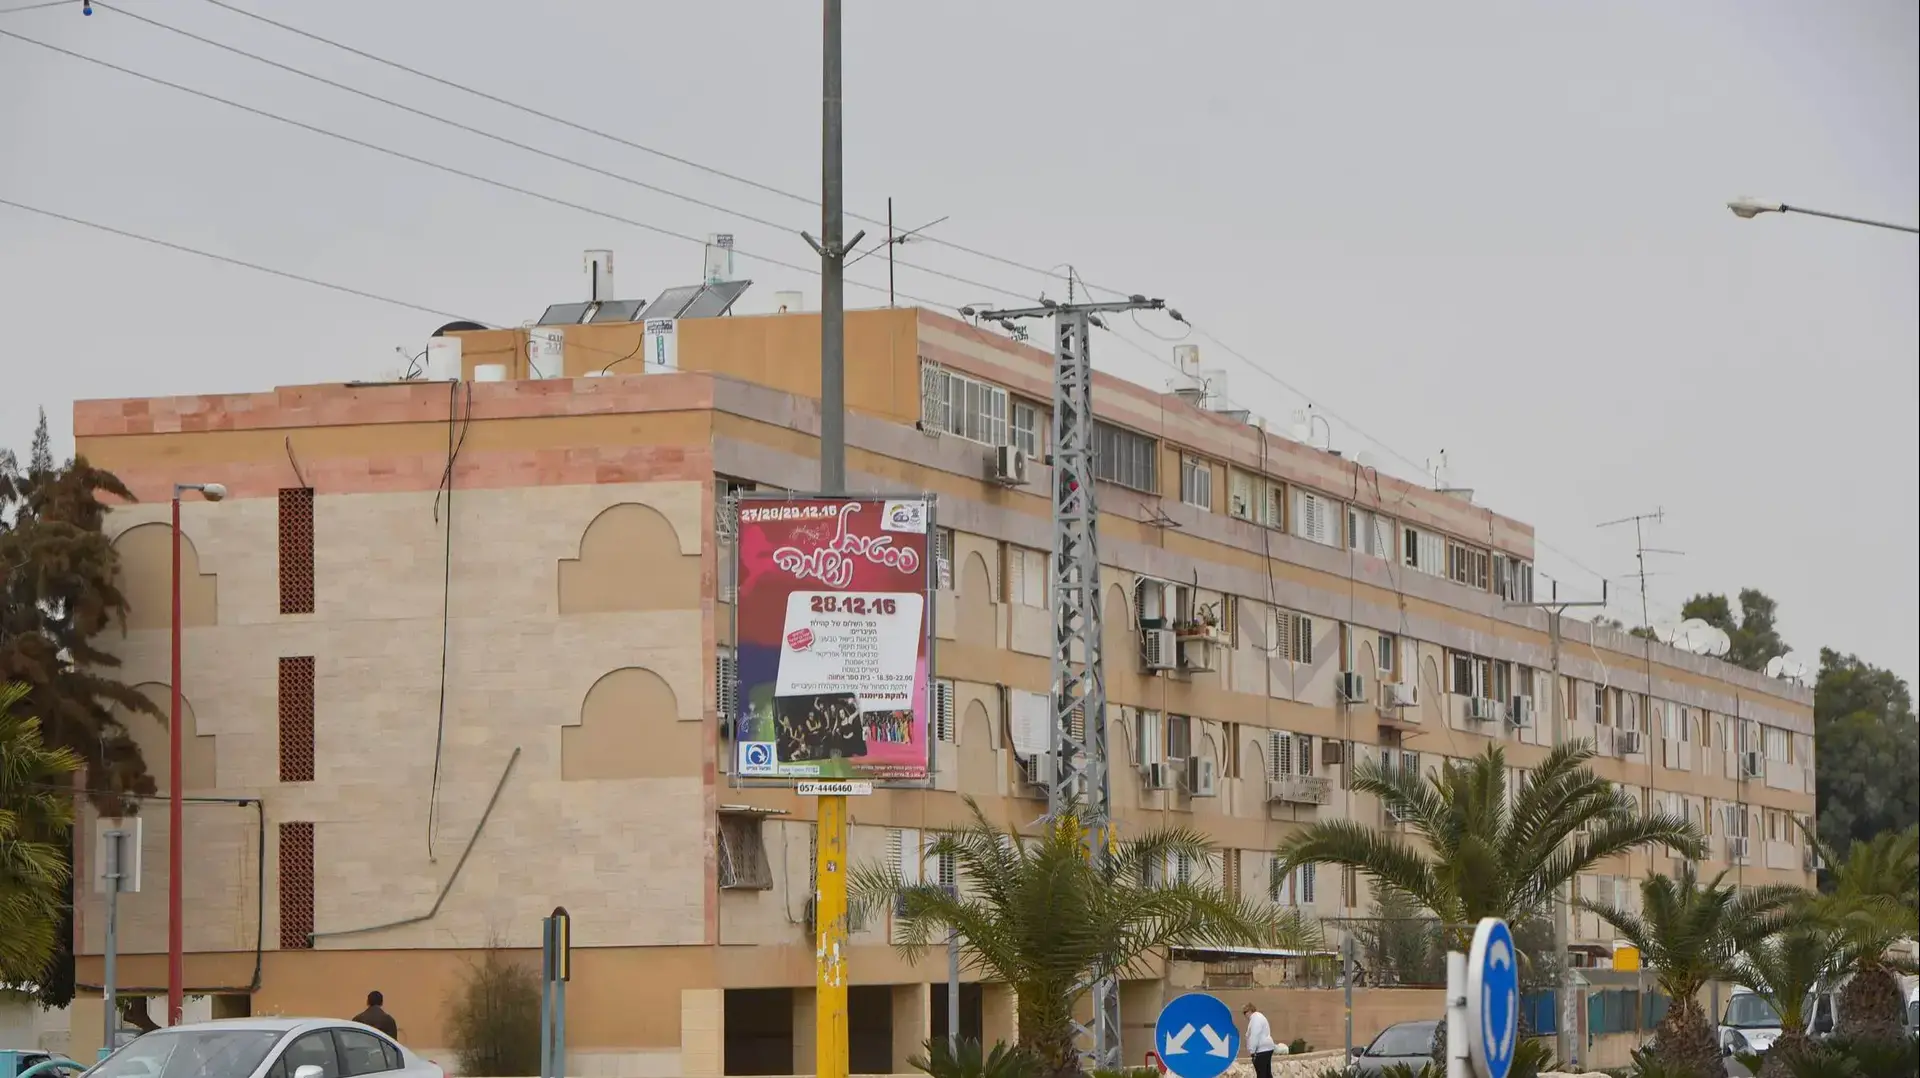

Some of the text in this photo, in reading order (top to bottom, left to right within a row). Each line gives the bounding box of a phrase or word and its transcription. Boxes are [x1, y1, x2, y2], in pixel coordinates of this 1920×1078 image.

[829, 502, 919, 574] פסטיבל
[810, 618, 830, 628] קהילת
[831, 619, 841, 627] של
[885, 691, 908, 700] ולהקת
[799, 784, 852, 792] 057-4446460
